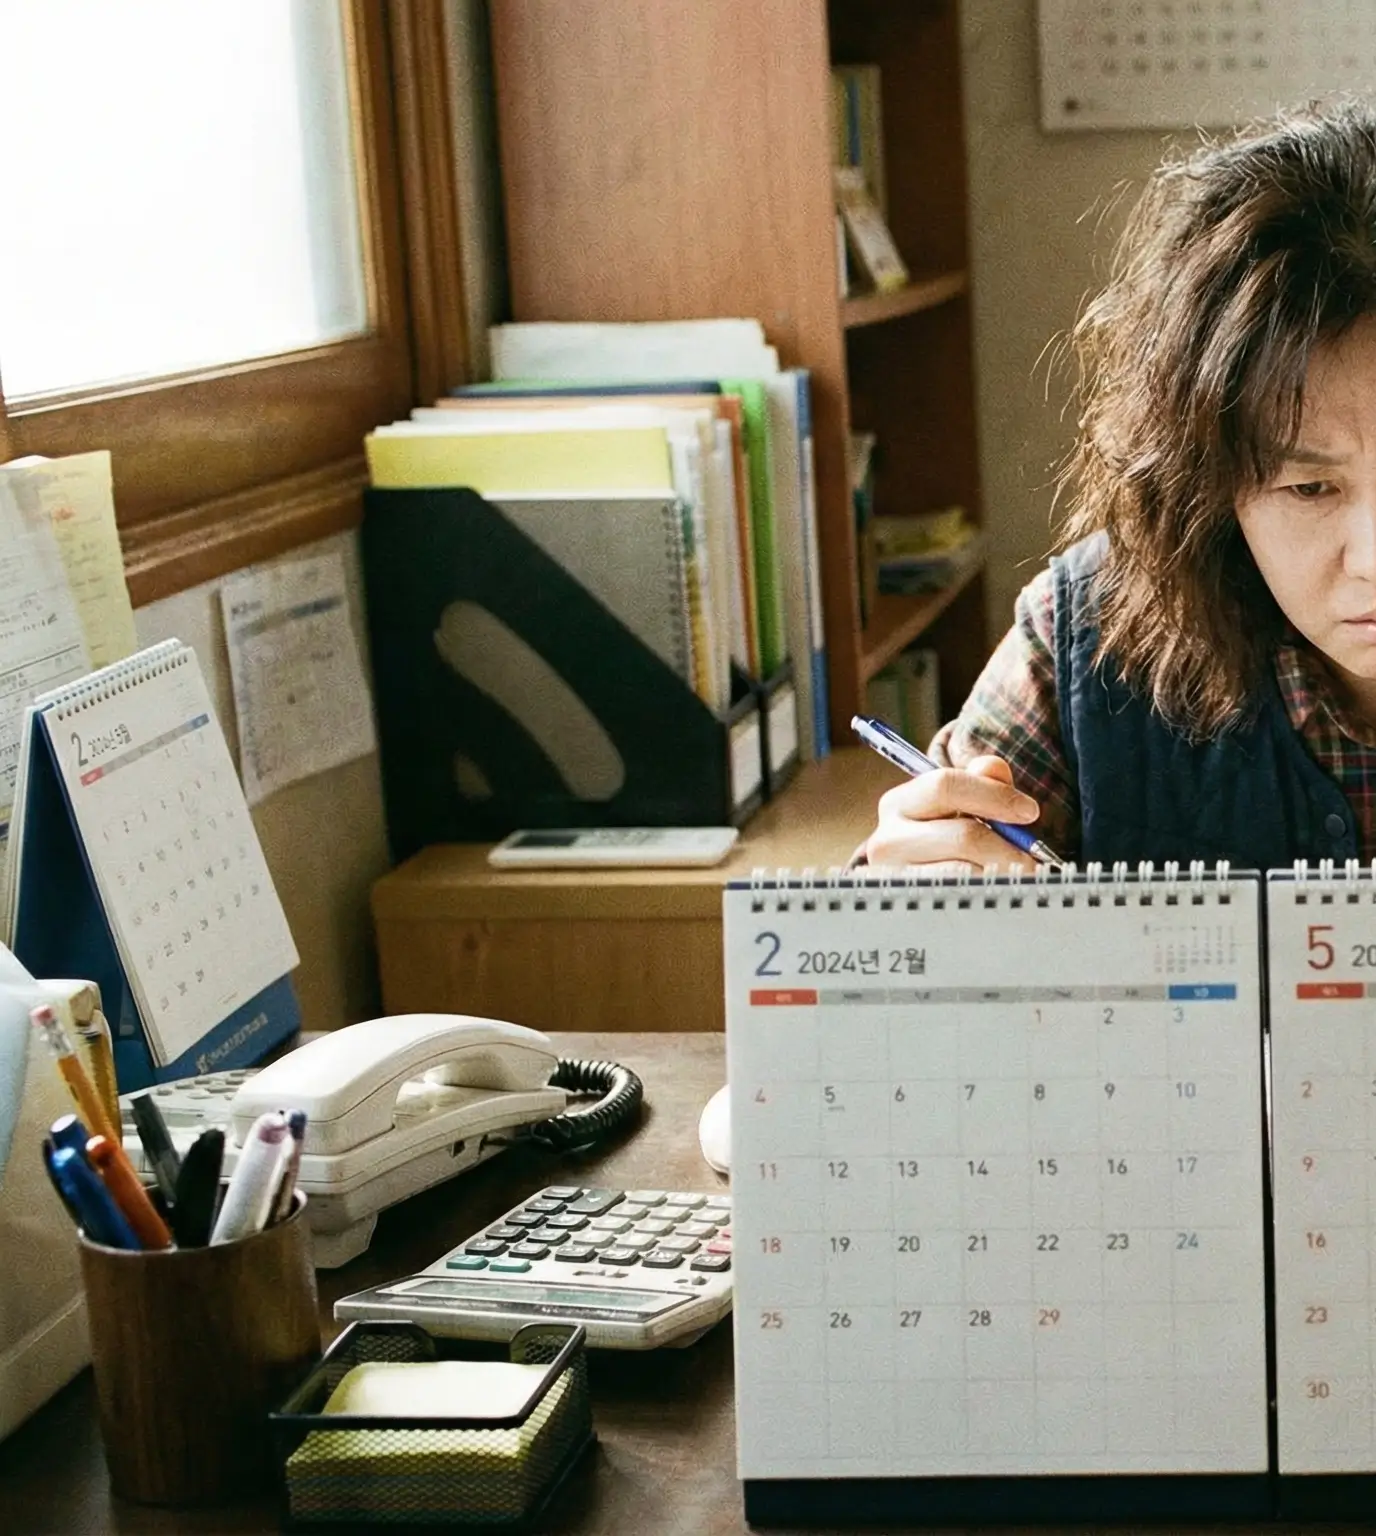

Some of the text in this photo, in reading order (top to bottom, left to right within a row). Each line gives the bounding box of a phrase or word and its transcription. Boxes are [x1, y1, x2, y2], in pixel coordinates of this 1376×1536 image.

[71, 731, 89, 767] 2
[754, 932, 927, 976] 2 2024년 2월
[1307, 925, 1335, 970] 5
[1034, 1006, 1184, 1025] 1 2 3
[824, 1086, 836, 1103] 5
[895, 1087, 906, 1102] 6
[965, 1084, 976, 1101] 7
[1034, 1084, 1045, 1100] 8
[1104, 1083, 1115, 1099] 9
[1176, 1082, 1197, 1099] 10
[1302, 1081, 1312, 1098] 2
[759, 1157, 1197, 1180] 11 12 13 14 15 16 17
[1303, 1156, 1313, 1172] 9
[760, 1233, 1199, 1254] 18 19 20 21 22 23 24
[1306, 1232, 1326, 1249] 16
[761, 1309, 1060, 1329] 25 26 27 28 29
[1305, 1307, 1327, 1324] 23
[1307, 1382, 1329, 1399] 30
